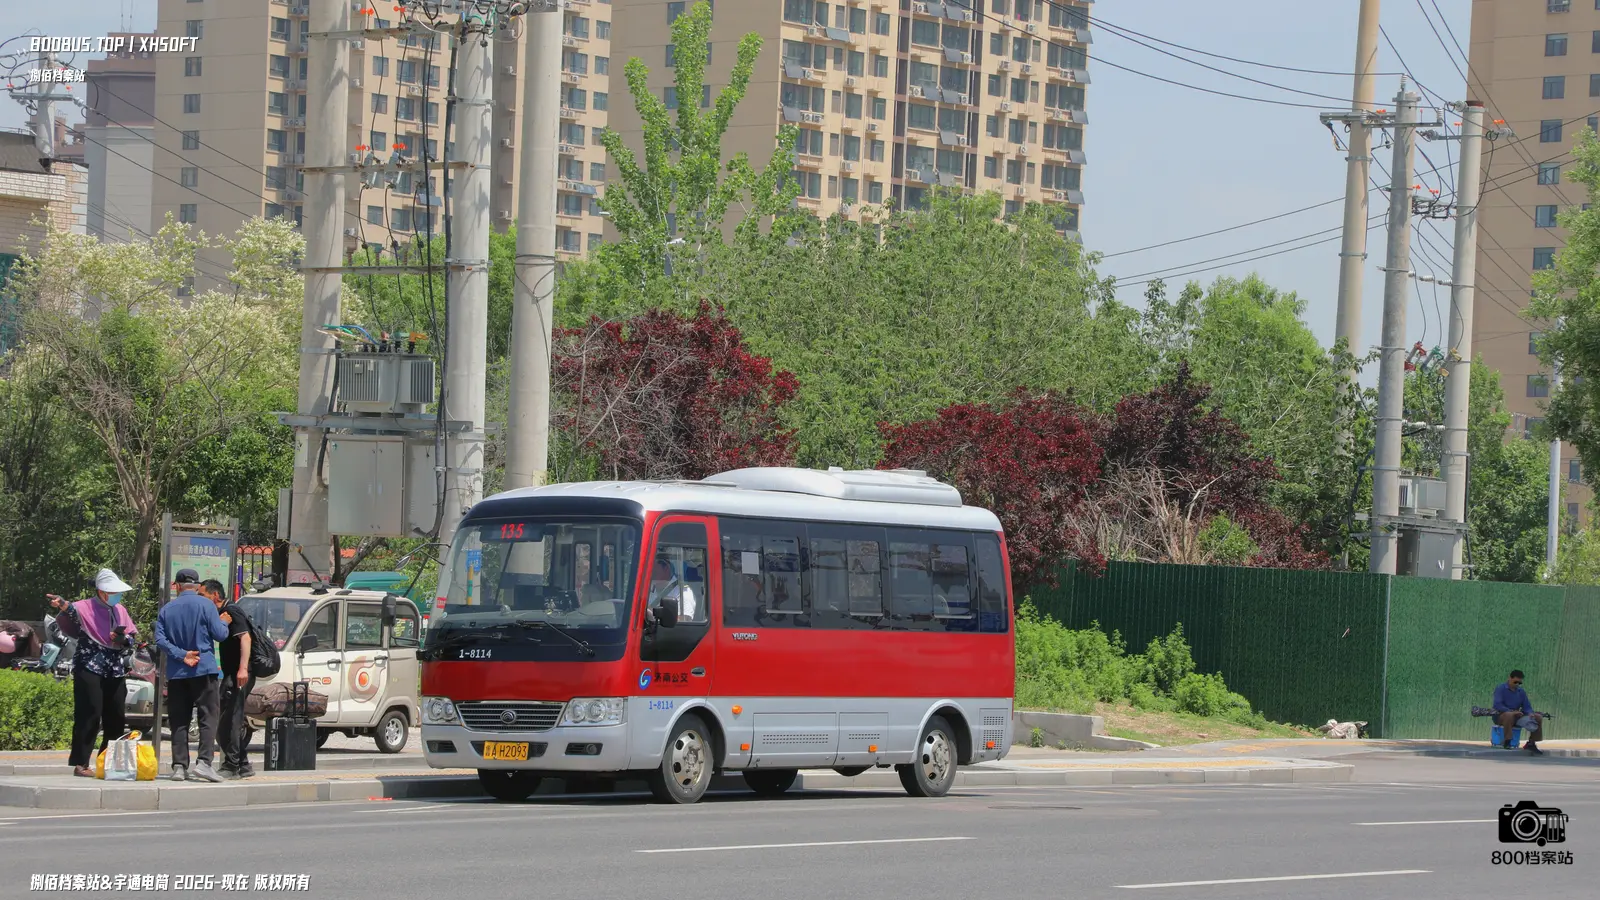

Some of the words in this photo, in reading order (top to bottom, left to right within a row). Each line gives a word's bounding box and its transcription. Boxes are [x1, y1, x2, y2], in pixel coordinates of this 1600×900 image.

[500, 523, 525, 539] 135
[459, 649, 492, 659] 1-8114
[648, 700, 674, 710] 1-8114
